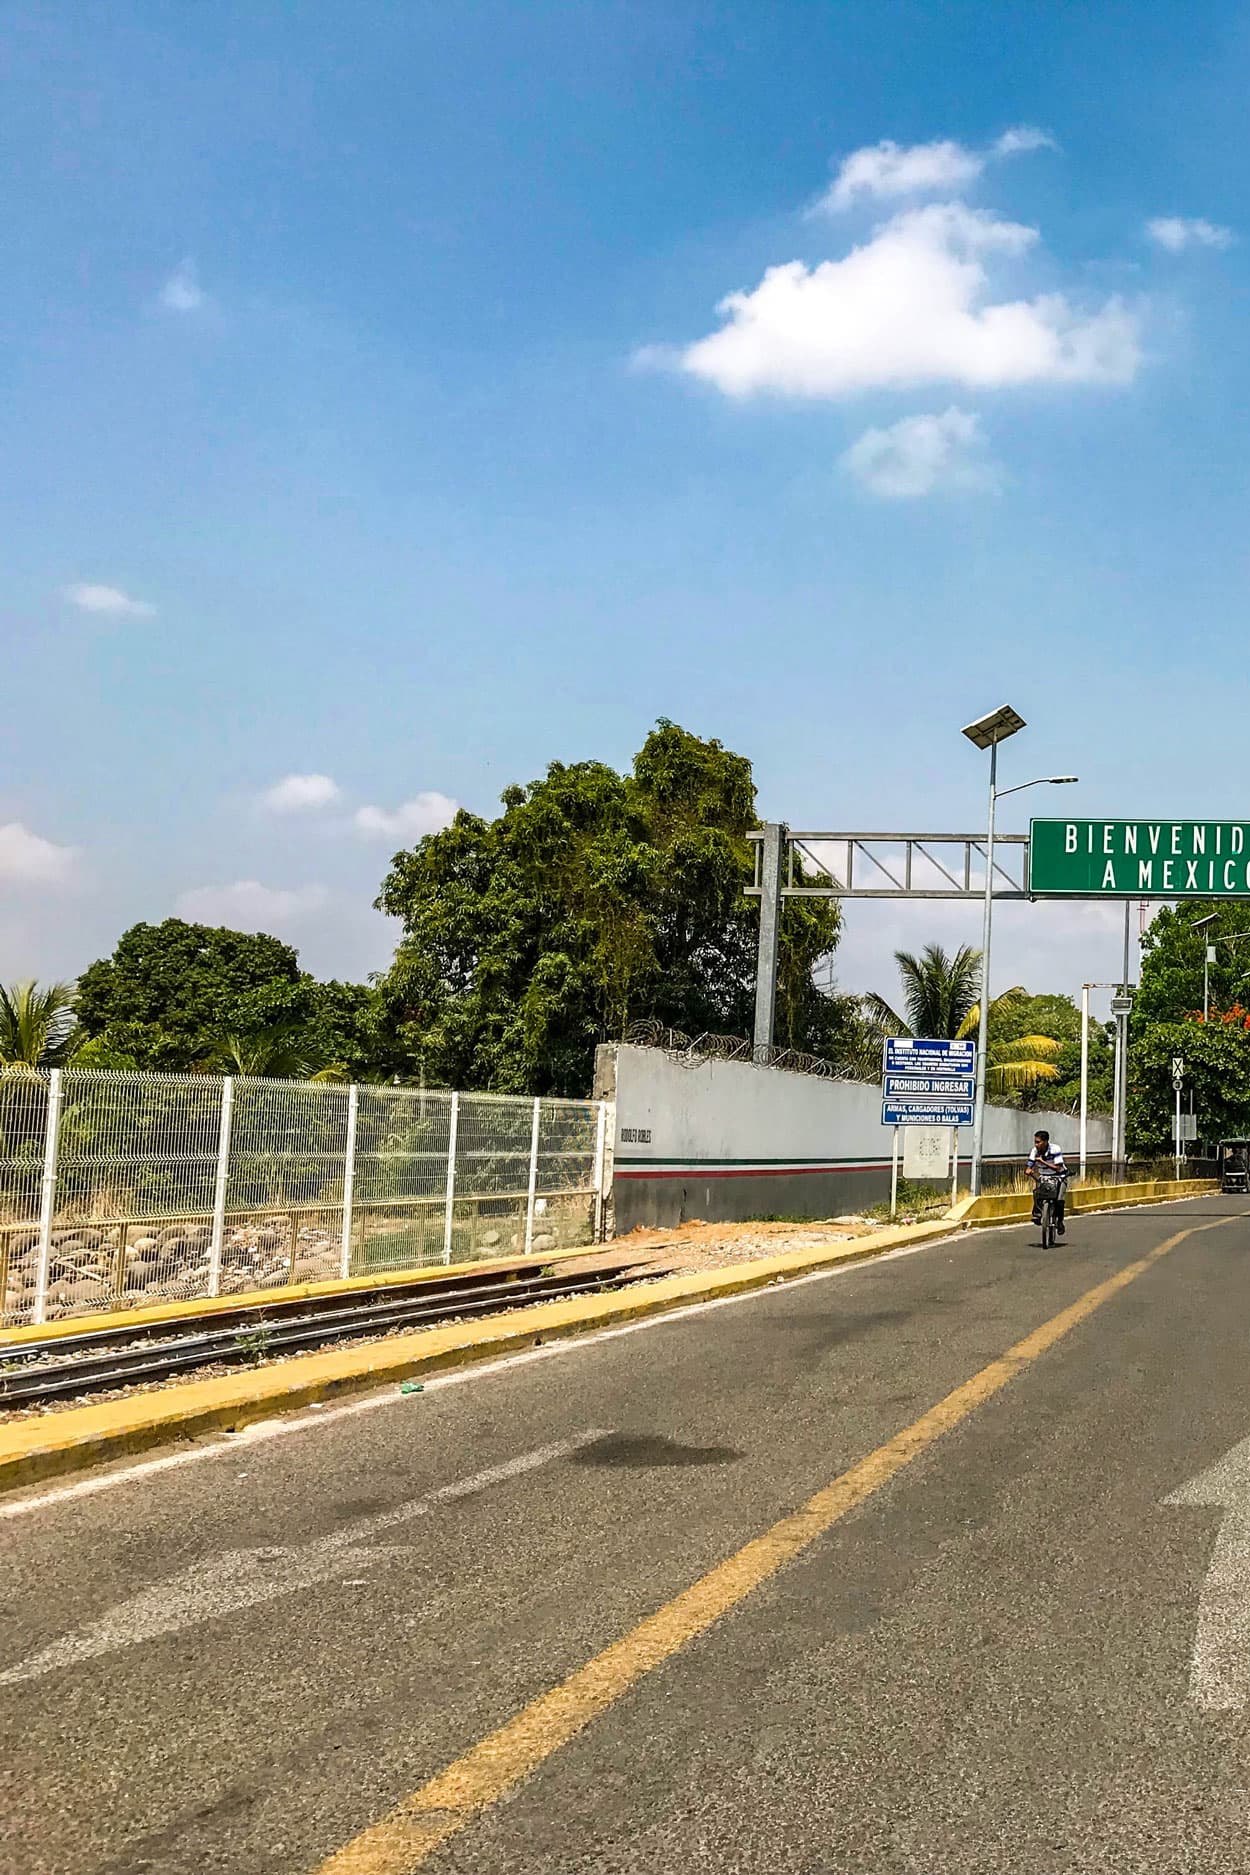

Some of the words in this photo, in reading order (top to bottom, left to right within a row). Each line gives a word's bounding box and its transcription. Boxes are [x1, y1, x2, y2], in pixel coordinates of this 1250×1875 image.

[1101, 860, 1116, 889] A
[889, 1079, 930, 1091] PROHIBIDO
[931, 1080, 969, 1092] INGRESAR
[887, 1105, 907, 1113] ARMAS,
[908, 1105, 944, 1113] CARGADORES
[945, 1106, 969, 1115] (TOLVAS)
[901, 1114, 935, 1122] MUNICIONES
